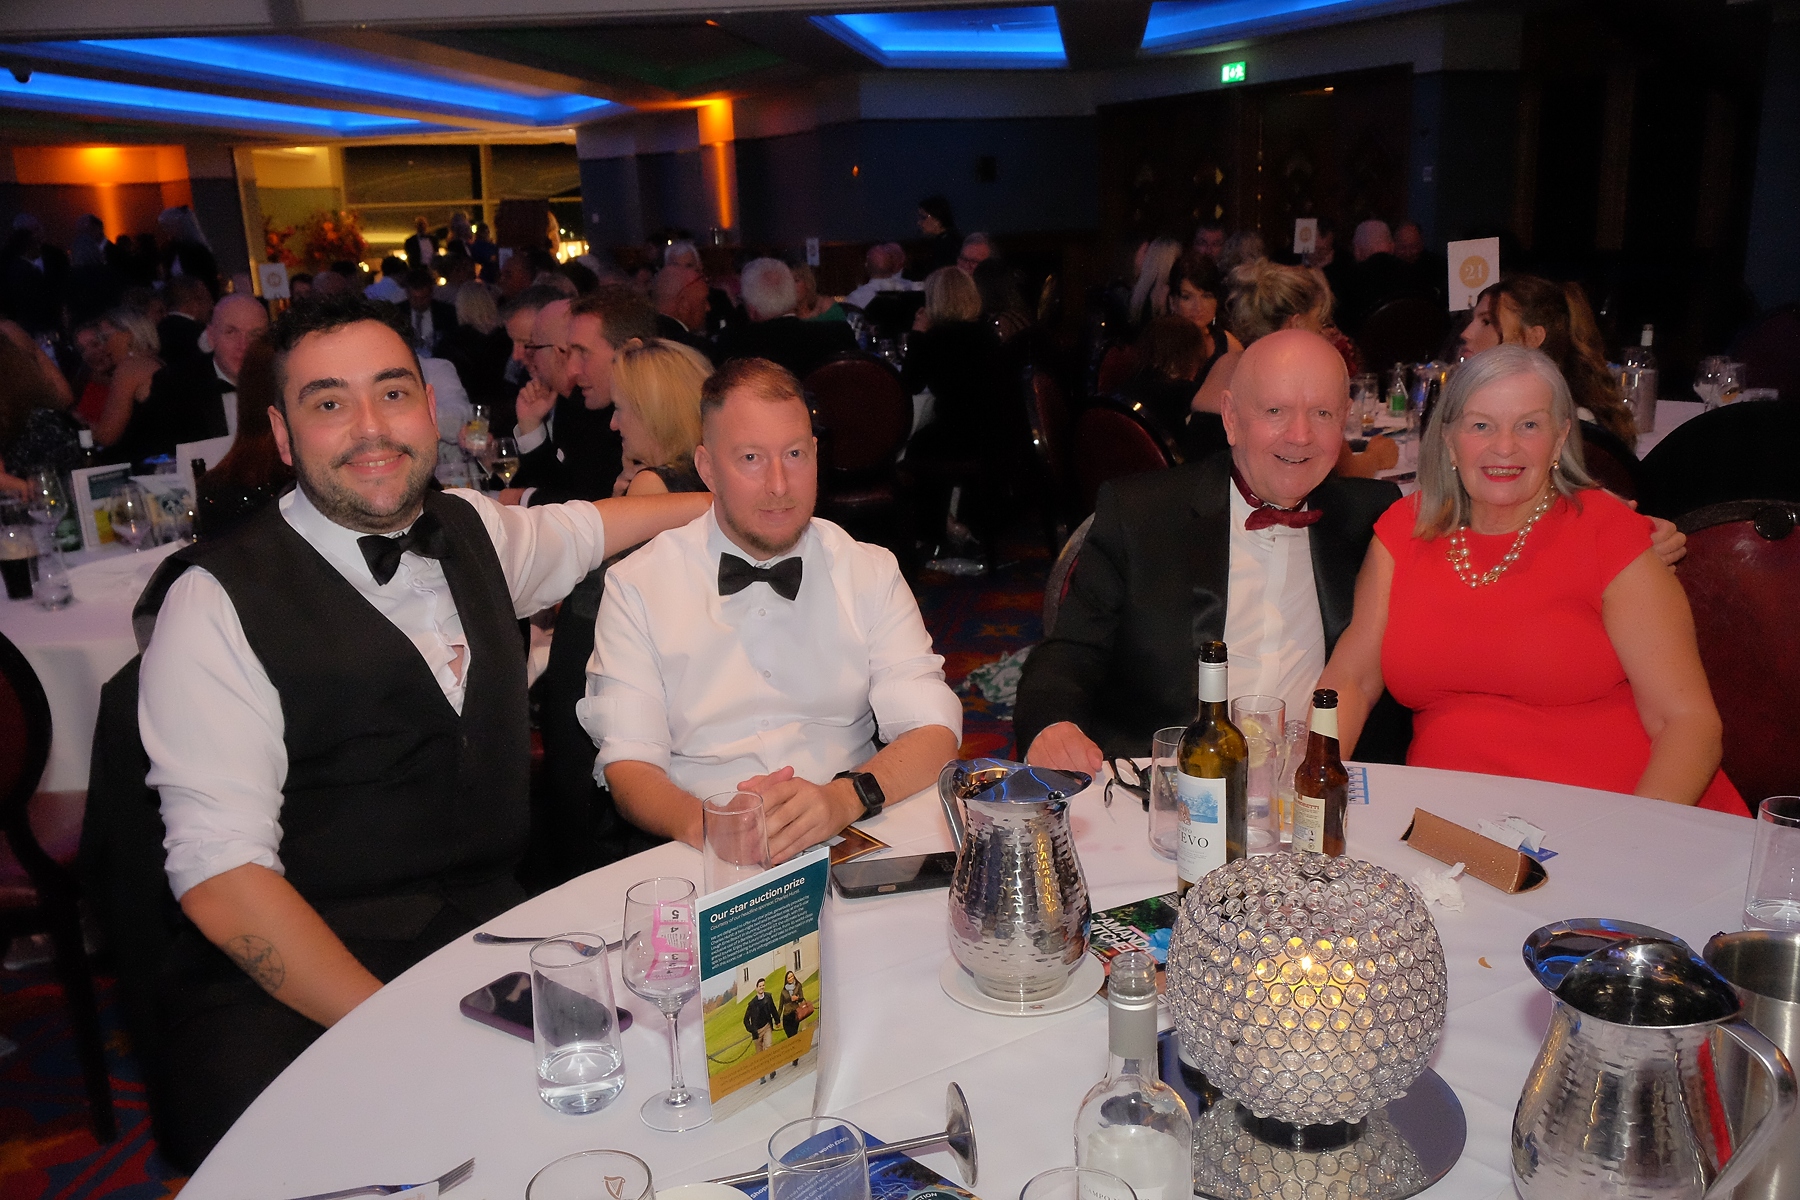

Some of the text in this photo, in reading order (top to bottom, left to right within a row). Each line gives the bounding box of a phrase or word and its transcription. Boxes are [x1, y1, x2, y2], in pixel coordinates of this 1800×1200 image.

[1465, 263, 1482, 280] 21
[710, 877, 805, 923] Our star auction prize
[671, 909, 680, 919] 5
[1097, 917, 1156, 954] AMANDA
[819, 1143, 835, 1154] worth
